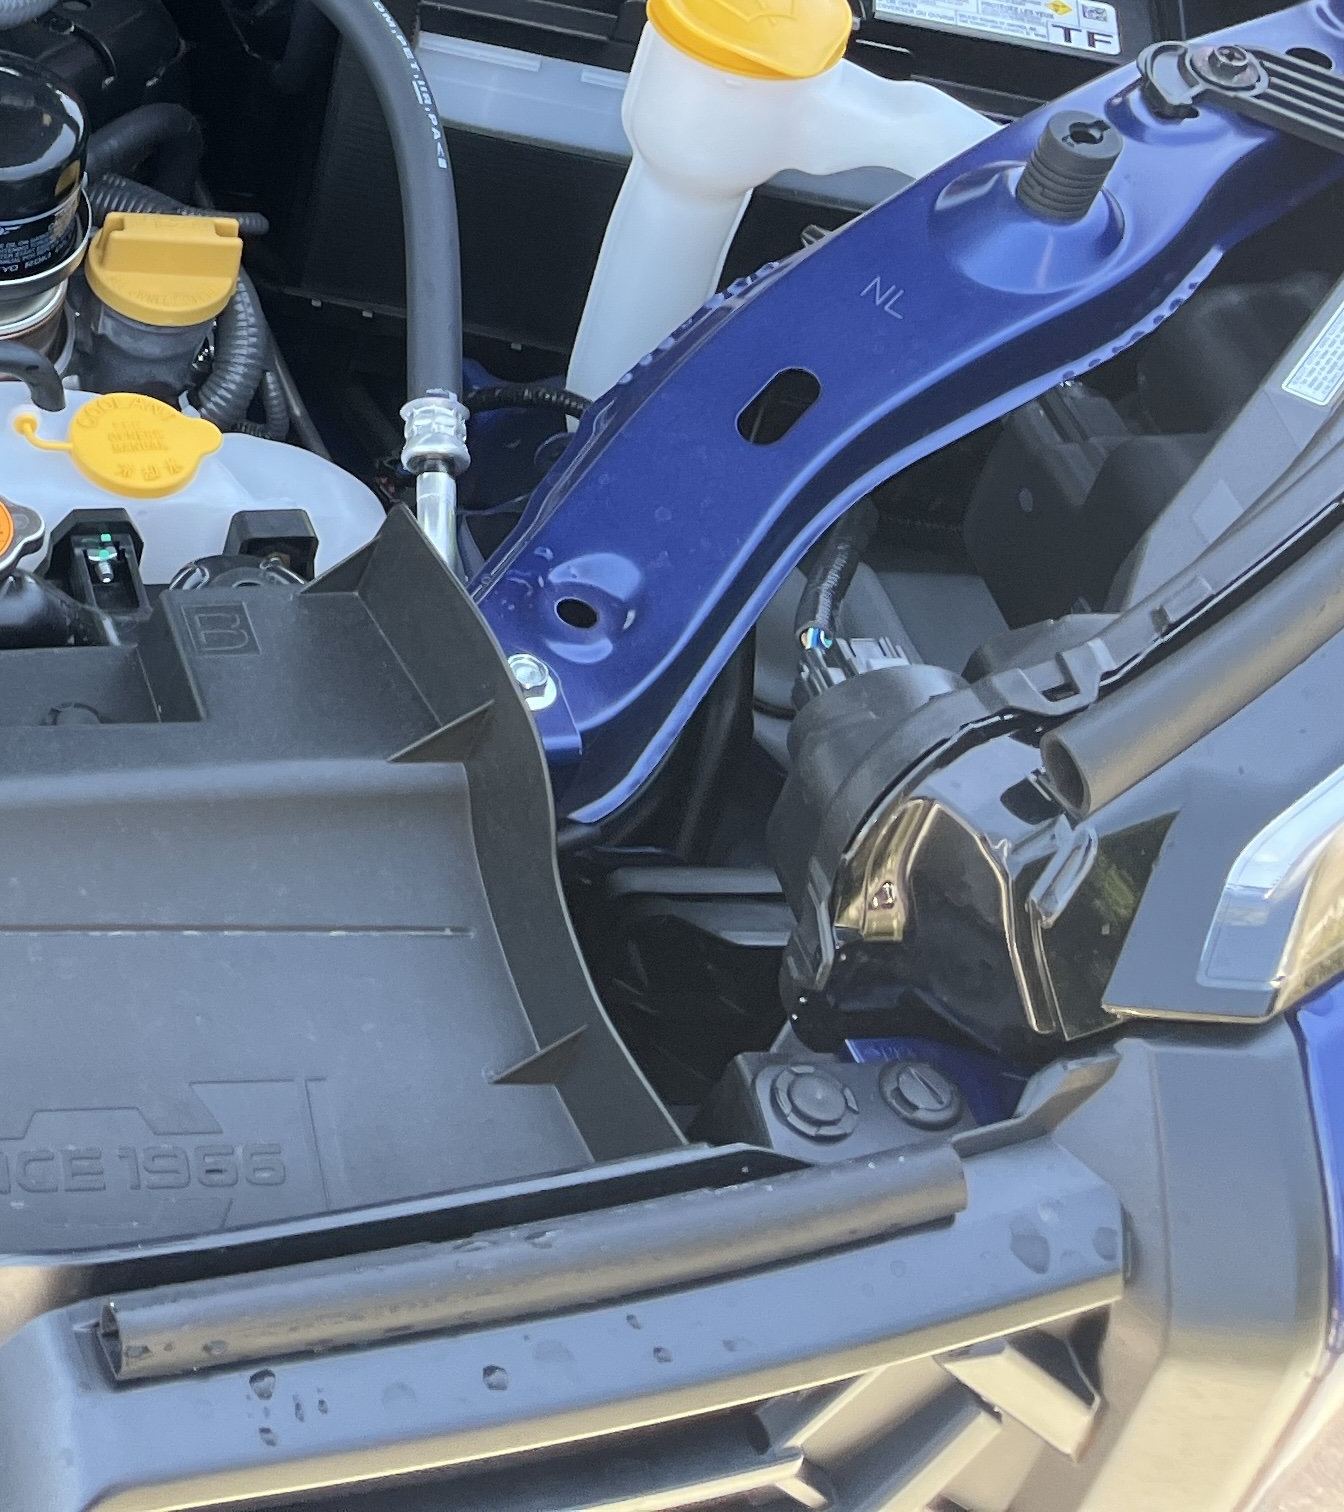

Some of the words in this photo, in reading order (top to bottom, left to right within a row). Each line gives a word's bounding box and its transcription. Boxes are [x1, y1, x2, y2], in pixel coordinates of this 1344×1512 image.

[1049, 24, 1113, 51] TF
[859, 275, 908, 320] NL
[118, 1142, 288, 1191] 1966
